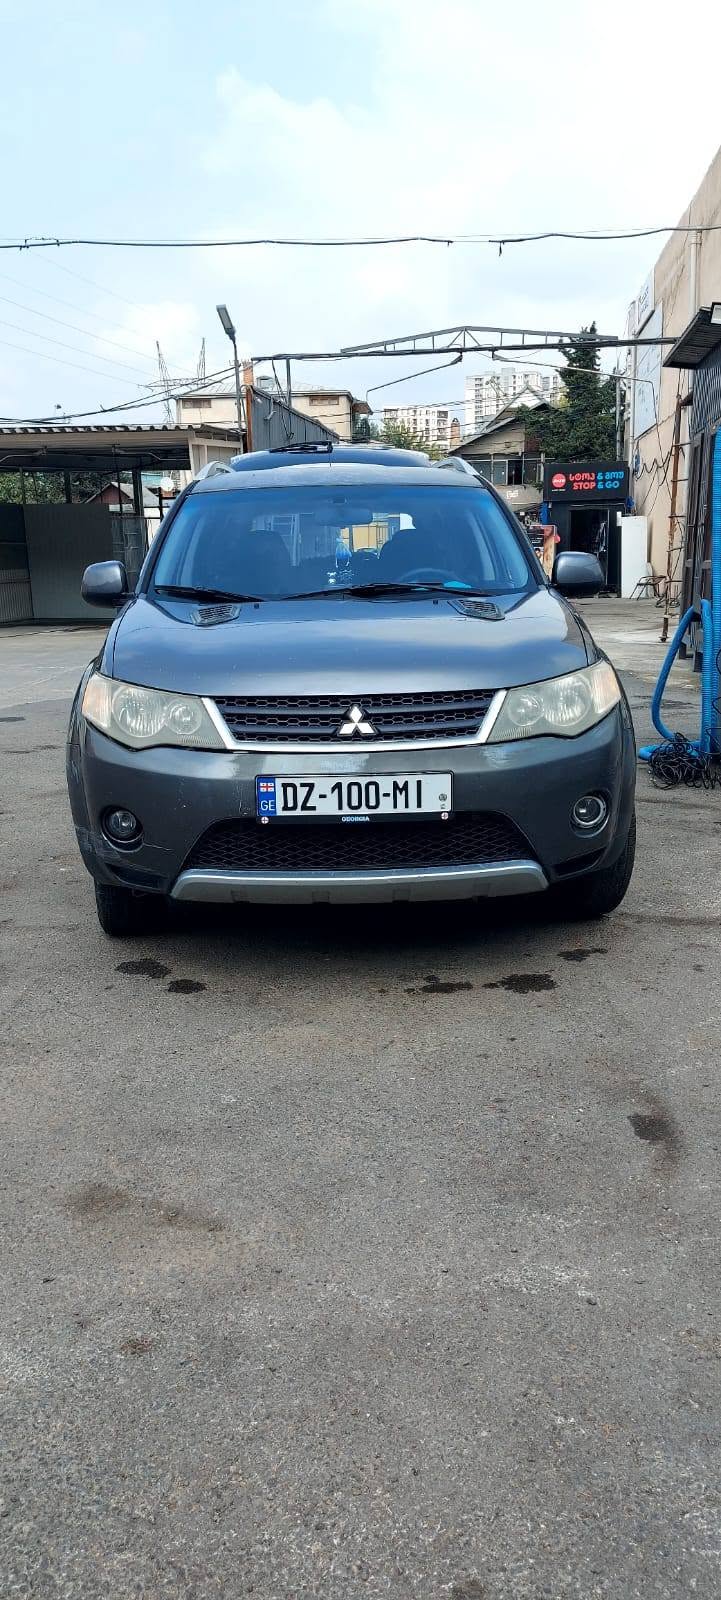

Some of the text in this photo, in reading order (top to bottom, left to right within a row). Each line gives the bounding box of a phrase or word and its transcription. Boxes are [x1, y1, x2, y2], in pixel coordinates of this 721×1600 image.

[596, 472, 603, 480] &
[572, 481, 596, 490] STOP
[597, 481, 603, 489] &
[605, 480, 620, 489] GO
[281, 780, 422, 811] DZ-100-MI
[260, 800, 276, 811] GE
